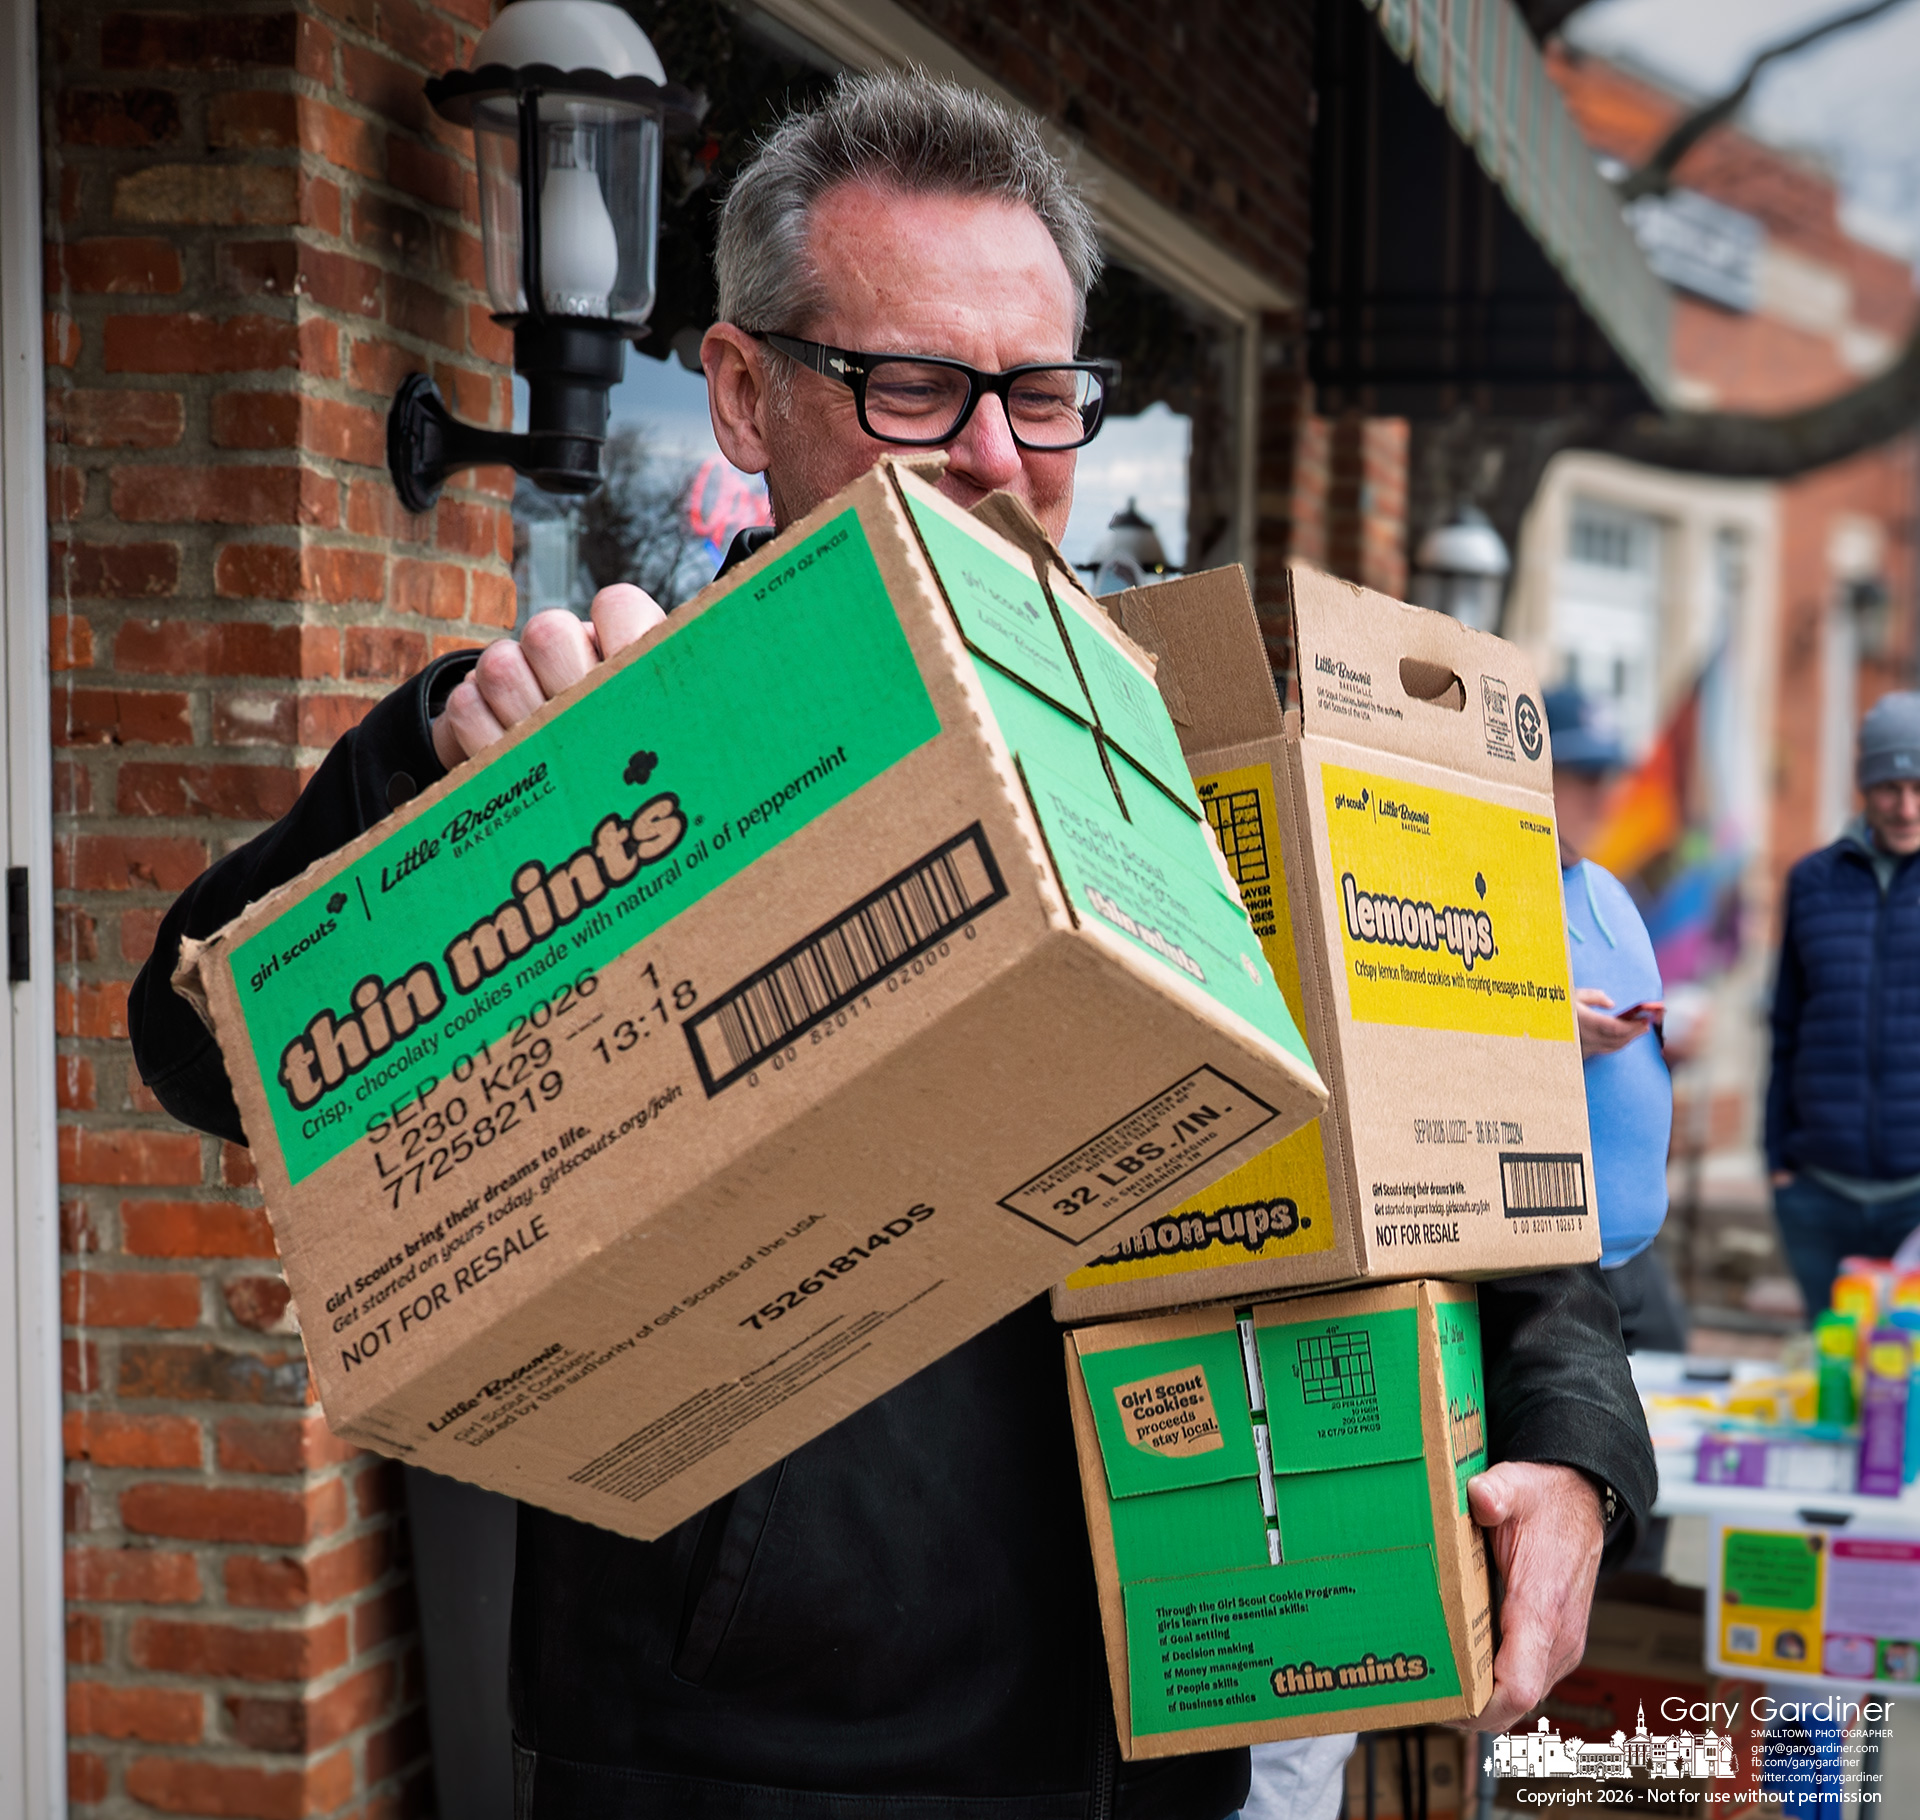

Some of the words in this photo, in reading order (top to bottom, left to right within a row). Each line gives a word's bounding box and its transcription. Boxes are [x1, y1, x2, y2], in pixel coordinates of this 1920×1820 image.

[754, 588, 766, 602] 12
[797, 555, 816, 572] OZ
[1314, 653, 1336, 676] Little
[1336, 662, 1372, 686] Brownie
[1335, 794, 1346, 810] girl
[1346, 798, 1366, 811] scouts
[1379, 798, 1398, 818] Little
[1398, 804, 1430, 826] Brownie
[250, 955, 280, 992] girl
[282, 918, 338, 964] scouts
[380, 838, 440, 894] Little
[440, 762, 548, 844] Brownie
[302, 1100, 353, 1140] Crisp,
[355, 1033, 438, 1102] chocolaty
[444, 980, 512, 1039] cookies
[515, 942, 568, 990] made
[572, 908, 612, 949] with
[615, 858, 683, 920] natural
[686, 840, 709, 869] oil
[712, 822, 733, 851] of
[736, 745, 848, 838] peppermint
[1354, 959, 1376, 982] Crispy
[1378, 962, 1399, 980] lemon
[1400, 964, 1426, 984] flavored
[1428, 970, 1450, 987] cookies
[1451, 972, 1466, 989] with
[1466, 974, 1492, 996] inspiring
[1492, 980, 1519, 999] messages
[1520, 983, 1527, 997] to
[1527, 980, 1536, 998] lift
[1536, 986, 1548, 1002] your
[1548, 985, 1566, 1004] spirits
[748, 1072, 759, 1088] 0
[773, 1046, 797, 1072] 00
[810, 997, 874, 1046] 82011
[886, 942, 950, 994] 02000
[964, 924, 978, 942] 0
[278, 961, 448, 1112] thin
[366, 1075, 440, 1145] SEP
[452, 1040, 493, 1083] 01
[507, 967, 598, 1048] 2026
[640, 961, 660, 990] 1
[480, 1038, 553, 1104] K29
[384, 1070, 563, 1210] 77258219
[592, 979, 698, 1064] 13:18
[1052, 1186, 1100, 1216] 32
[1372, 1182, 1382, 1197] Girl
[1384, 1183, 1401, 1196] Scouts
[1401, 1182, 1416, 1199] bring
[1416, 1182, 1430, 1196] their
[1430, 1182, 1450, 1196] dreams
[1450, 1184, 1456, 1194] to
[325, 1284, 354, 1314] Girl
[354, 1250, 404, 1294] Scouts
[404, 1220, 446, 1258] bring
[445, 1198, 480, 1228] their
[484, 1160, 540, 1204] dreams
[542, 1142, 559, 1164] to
[558, 1124, 592, 1150] life.
[332, 1306, 361, 1334] Get
[362, 1268, 416, 1316] started
[419, 1252, 440, 1274] on
[439, 1220, 486, 1266] yours
[487, 1190, 540, 1226] today.
[538, 1084, 684, 1196] girlscouts.org/join
[1374, 1204, 1384, 1216] Get
[1385, 1203, 1406, 1215] started
[1406, 1204, 1412, 1214] on
[1414, 1204, 1428, 1218] yours
[1428, 1201, 1446, 1216] today.
[1446, 1200, 1490, 1216] girlscouts.org/join
[1376, 1224, 1399, 1247] NOT
[1400, 1223, 1422, 1245] FOR
[1424, 1222, 1460, 1243] RESALE
[1512, 1220, 1518, 1234] 0
[1520, 1220, 1530, 1234] 00
[1532, 1218, 1552, 1234] 82011
[1556, 1218, 1576, 1232] 10263
[1578, 1218, 1583, 1231] 8
[738, 1202, 937, 1332] 75261814DS
[341, 1319, 394, 1372] NOT
[398, 1283, 452, 1332] FOR
[452, 1214, 550, 1296] RESALE
[514, 1400, 540, 1417] by
[635, 1324, 656, 1340] of
[682, 1269, 740, 1308] Scouts
[736, 1254, 760, 1274] of
[757, 1236, 787, 1258] the
[427, 1396, 480, 1434] Little
[476, 1342, 564, 1398] Brownie
[1121, 1388, 1153, 1408] Girl
[1155, 1375, 1204, 1400] Scout
[1136, 1410, 1196, 1440] proceeds
[1152, 1430, 1179, 1448] stay
[1182, 1418, 1219, 1439] local.
[1318, 1430, 1326, 1438] 12
[1327, 1428, 1346, 1438] CT/9
[1347, 1426, 1358, 1435] OZ
[1360, 1422, 1380, 1433] PKGS
[1156, 1602, 1197, 1618] Through
[1199, 1600, 1216, 1612] the
[1217, 1597, 1236, 1610] Girl
[1238, 1594, 1266, 1608] Scout
[1269, 1591, 1303, 1605] Cookie
[1158, 1619, 1180, 1634] girls
[1182, 1616, 1208, 1629] learn
[1210, 1612, 1230, 1625] five
[1232, 1606, 1278, 1622] essential
[1279, 1603, 1310, 1616] skills:
[1170, 1631, 1194, 1644] Goal
[1196, 1628, 1230, 1642] setting
[1172, 1648, 1216, 1662] Decision
[1218, 1642, 1254, 1656] making
[1175, 1665, 1208, 1679] Money
[1210, 1656, 1274, 1673] management
[1270, 1661, 1338, 1698] thin
[1177, 1680, 1210, 1696] People
[1212, 1678, 1238, 1690] skills
[1180, 1698, 1224, 1712] Business
[1226, 1692, 1257, 1706] ethics
